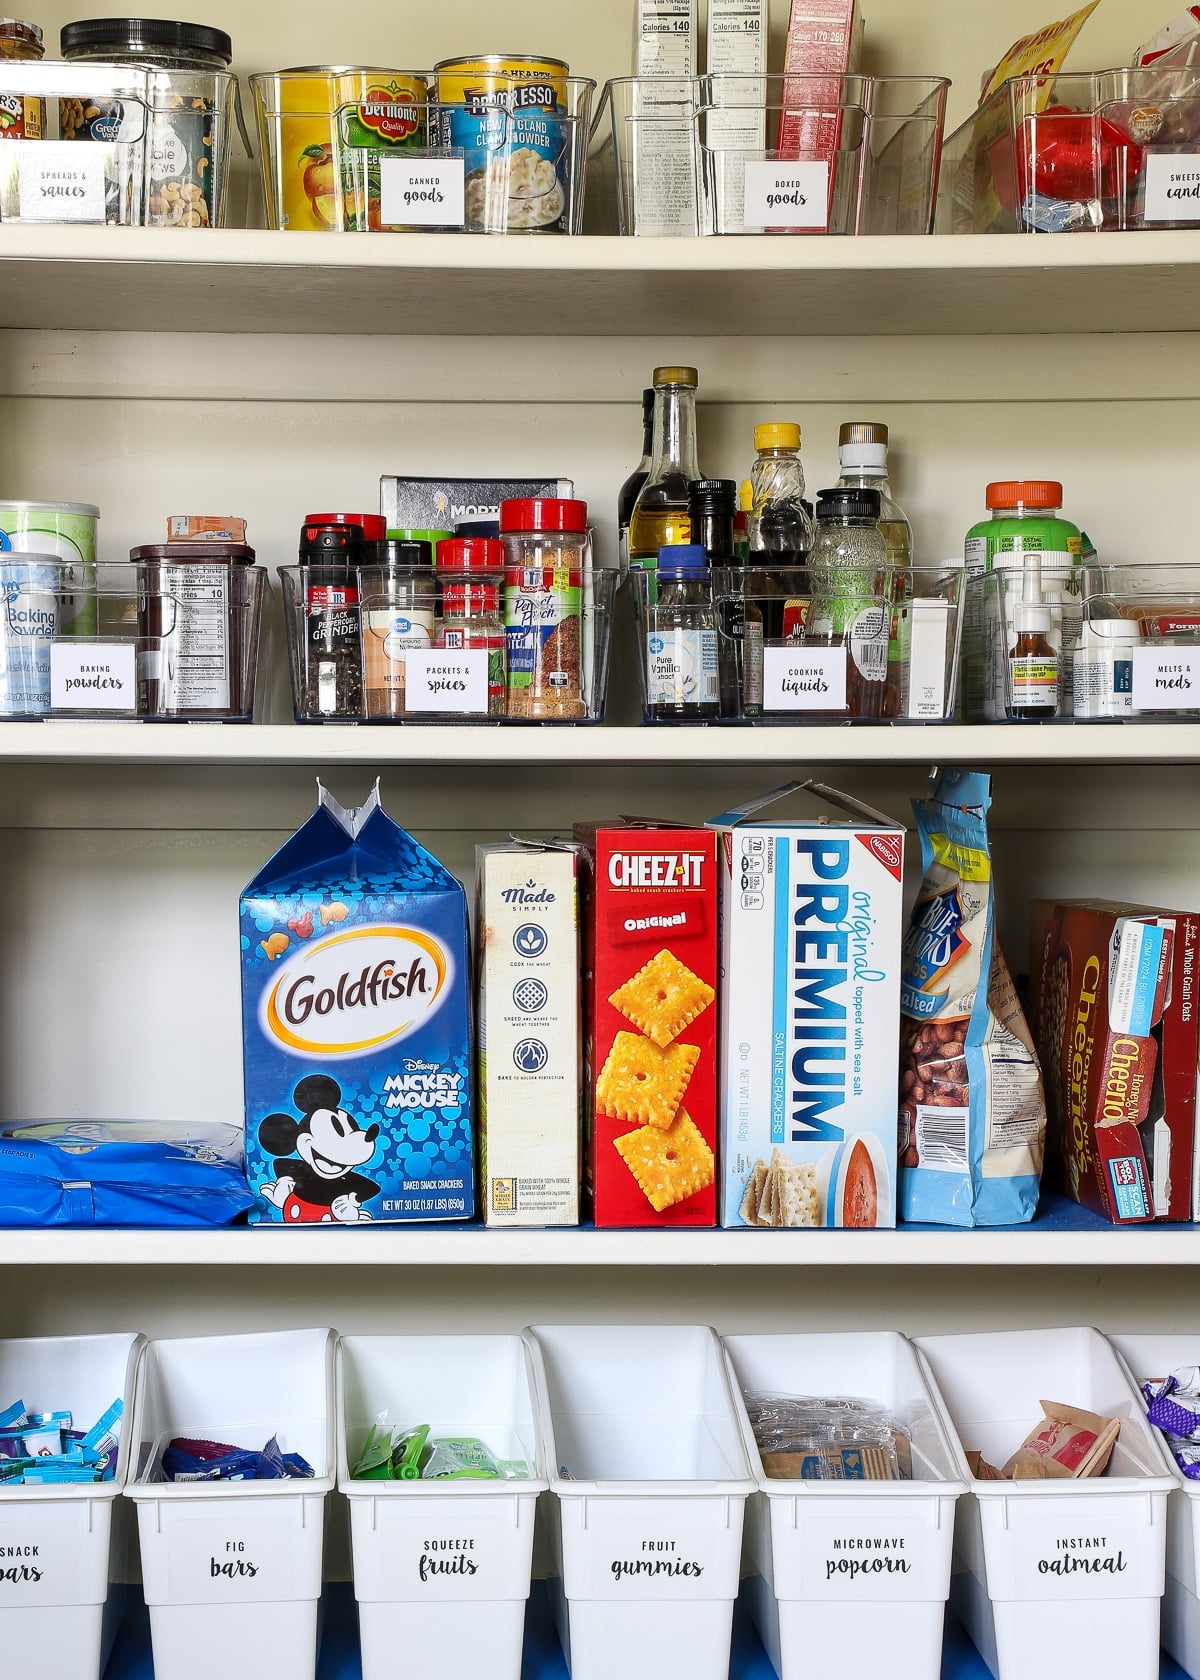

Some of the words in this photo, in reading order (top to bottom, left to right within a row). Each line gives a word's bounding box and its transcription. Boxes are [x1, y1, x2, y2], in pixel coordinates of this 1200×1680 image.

[643, 23, 670, 31] Calories
[673, 21, 690, 31] 140
[713, 22, 741, 31] Calories
[743, 20, 760, 30] 140
[814, 31, 828, 41] 170
[830, 31, 845, 42] 280
[381, 120, 405, 133] Quality
[40, 171, 78, 181] SPREADS
[409, 177, 440, 185] CANNED
[775, 180, 801, 188] BOXED
[1170, 173, 1200, 182] SWEETS
[40, 183, 87, 198] sauces
[403, 187, 445, 205] goods
[766, 190, 808, 209] goods
[211, 589, 223, 598] 10
[325, 611, 348, 622] BLACK
[312, 622, 359, 641] GRINDER
[792, 623, 806, 636] Mrs
[656, 656, 673, 664] Pure
[80, 665, 110, 673] BAKING
[426, 667, 461, 675] PACKETS
[464, 667, 470, 675] &
[651, 664, 681, 673] Vanilla
[788, 668, 824, 676] COOKING
[1158, 665, 1183, 673] MELTS
[1186, 665, 1192, 673] &
[65, 675, 123, 693] powders
[427, 678, 467, 694] spices
[781, 678, 830, 696] liquids
[1155, 674, 1192, 690] meds
[753, 841, 762, 851] 70
[871, 839, 898, 865] NABISCO
[501, 888, 556, 904] Made
[836, 891, 886, 982] original
[1183, 948, 1194, 975] Whole
[284, 956, 428, 1025] Goldfish
[792, 839, 851, 1143] PREMIUM
[1182, 977, 1193, 1001] Grain
[853, 985, 864, 1024] topped
[902, 990, 936, 1014] alted
[1181, 1002, 1193, 1022] Oats
[853, 1028, 863, 1050] with
[774, 1032, 785, 1074] SALTINE
[402, 1057, 441, 1073] Disney
[853, 1053, 862, 1073] sea
[1072, 955, 1100, 1174] Cheerios
[382, 1071, 462, 1092] MICKEY
[740, 1069, 750, 1084] NET
[739, 1085, 749, 1099] WT
[853, 1075, 863, 1097] salt
[1129, 1073, 1145, 1107] Honey
[385, 1089, 460, 1110] MOUSE
[773, 1076, 784, 1135] CRACKERS
[1119, 1163, 1129, 1185] TOPS
[1123, 1159, 1134, 1181] BOX
[1136, 1158, 1146, 1191] DOWNLOAD
[403, 1181, 419, 1191] BAKED
[420, 1180, 437, 1190] SNACK
[437, 1179, 463, 1190] CRACKERS
[382, 1200, 393, 1211] NET
[394, 1199, 404, 1211] WT
[404, 1199, 412, 1210] 30
[412, 1199, 421, 1210] OZ
[420, 1198, 433, 1211] (1.87
[434, 1198, 447, 1210] LBS)
[447, 1197, 464, 1211] (850g)
[1131, 1186, 1143, 1215] SCAN
[0, 1545, 40, 1557] SNACK
[226, 1541, 245, 1552] FIG
[424, 1539, 475, 1551] SQUEEZE
[641, 1541, 676, 1552] FRUIT
[833, 1538, 906, 1550] MICROWAVE
[1056, 1537, 1107, 1549] INSTANT
[210, 1557, 259, 1578] bars
[419, 1553, 479, 1582] fruits
[611, 1557, 704, 1581] gummies
[825, 1558, 911, 1579] popcorn
[1037, 1551, 1127, 1576] oatmeal
